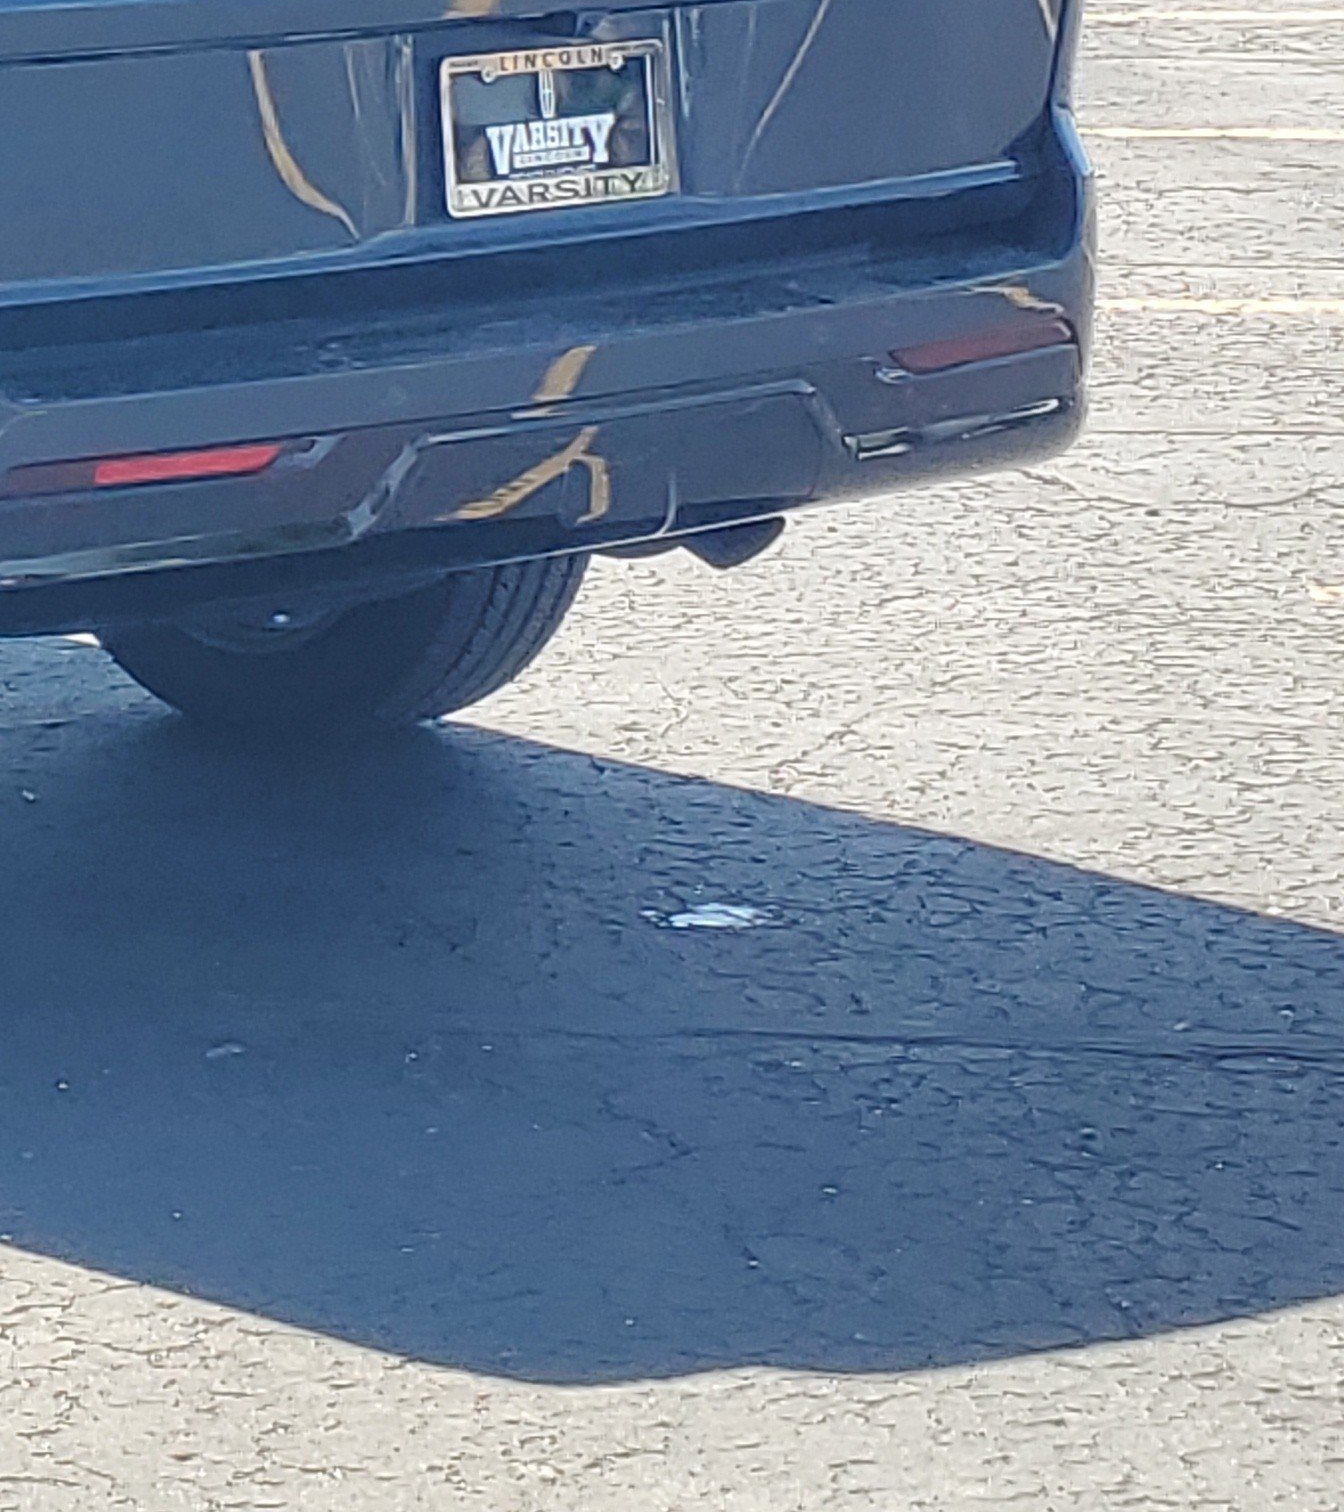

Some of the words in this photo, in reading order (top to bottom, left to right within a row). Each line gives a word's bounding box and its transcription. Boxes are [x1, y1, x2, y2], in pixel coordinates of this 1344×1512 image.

[499, 46, 603, 72] LINCOLN
[485, 112, 616, 176] VARSITY
[471, 171, 644, 209] VARSITY
